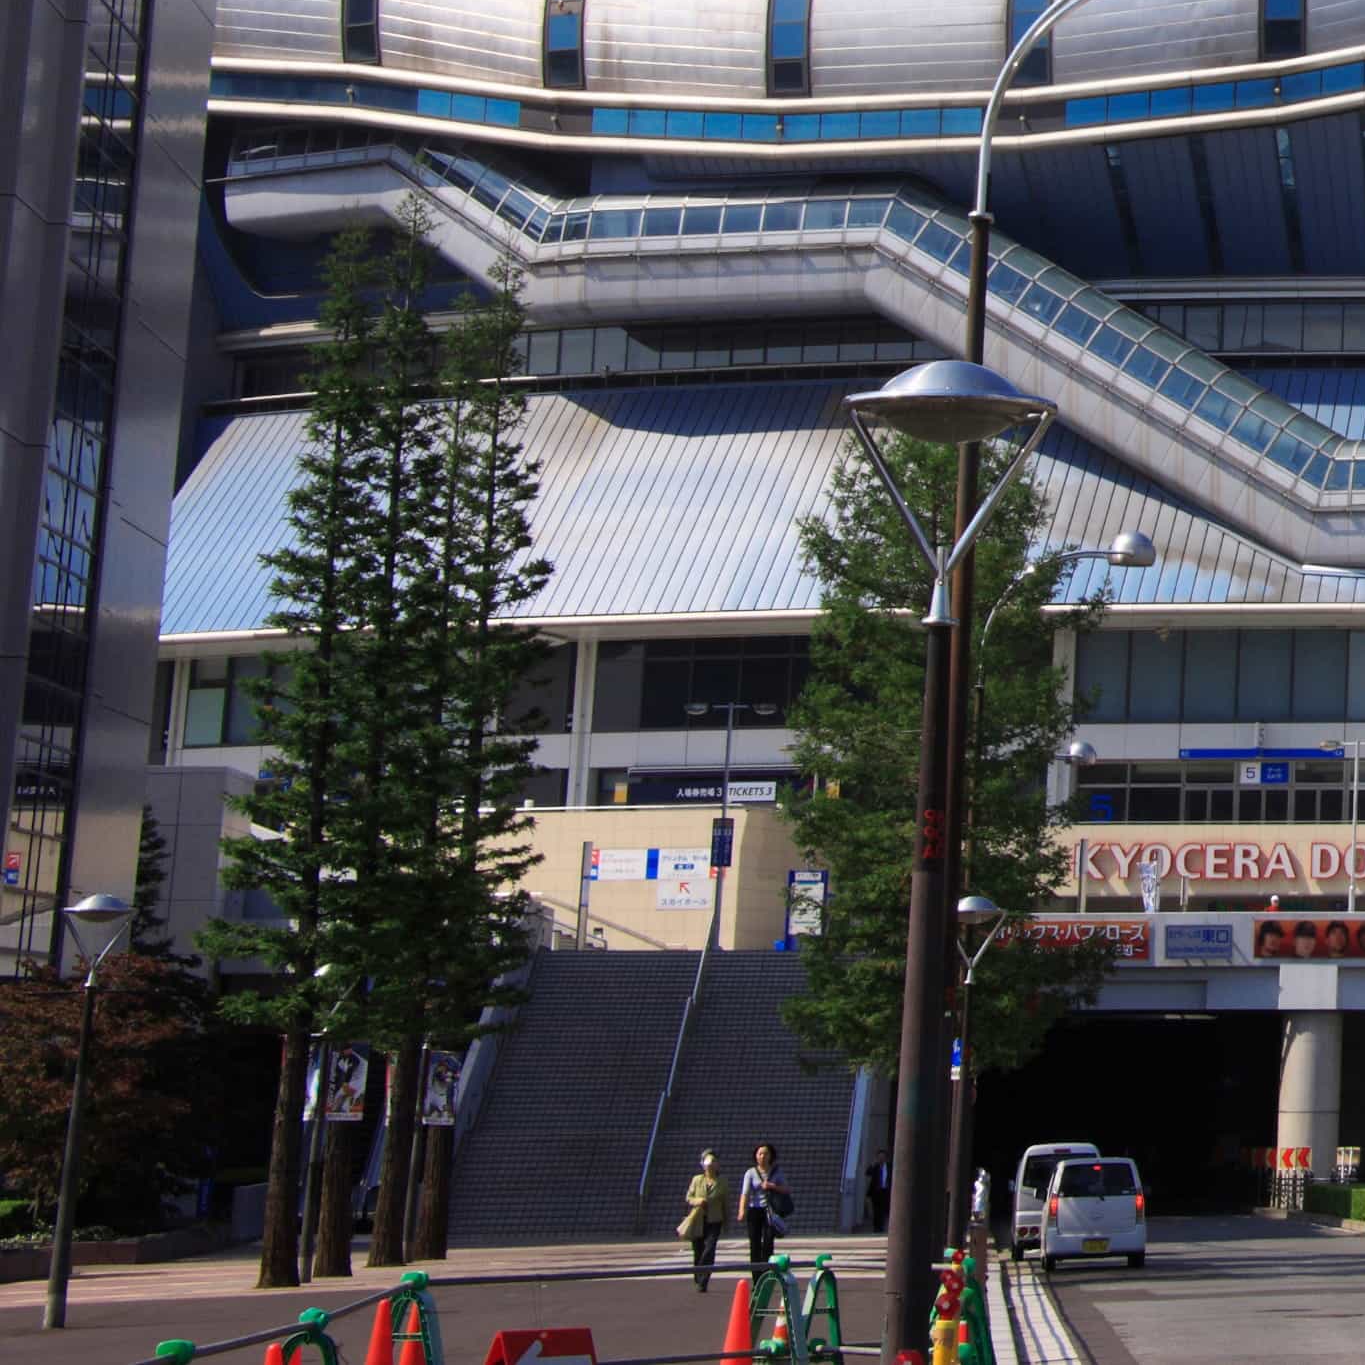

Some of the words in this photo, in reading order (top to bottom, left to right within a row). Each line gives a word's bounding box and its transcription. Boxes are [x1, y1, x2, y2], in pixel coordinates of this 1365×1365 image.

[1245, 766, 1257, 780] 5
[728, 787, 764, 796] TICKETS
[1074, 842, 1296, 880] KYOCERA
